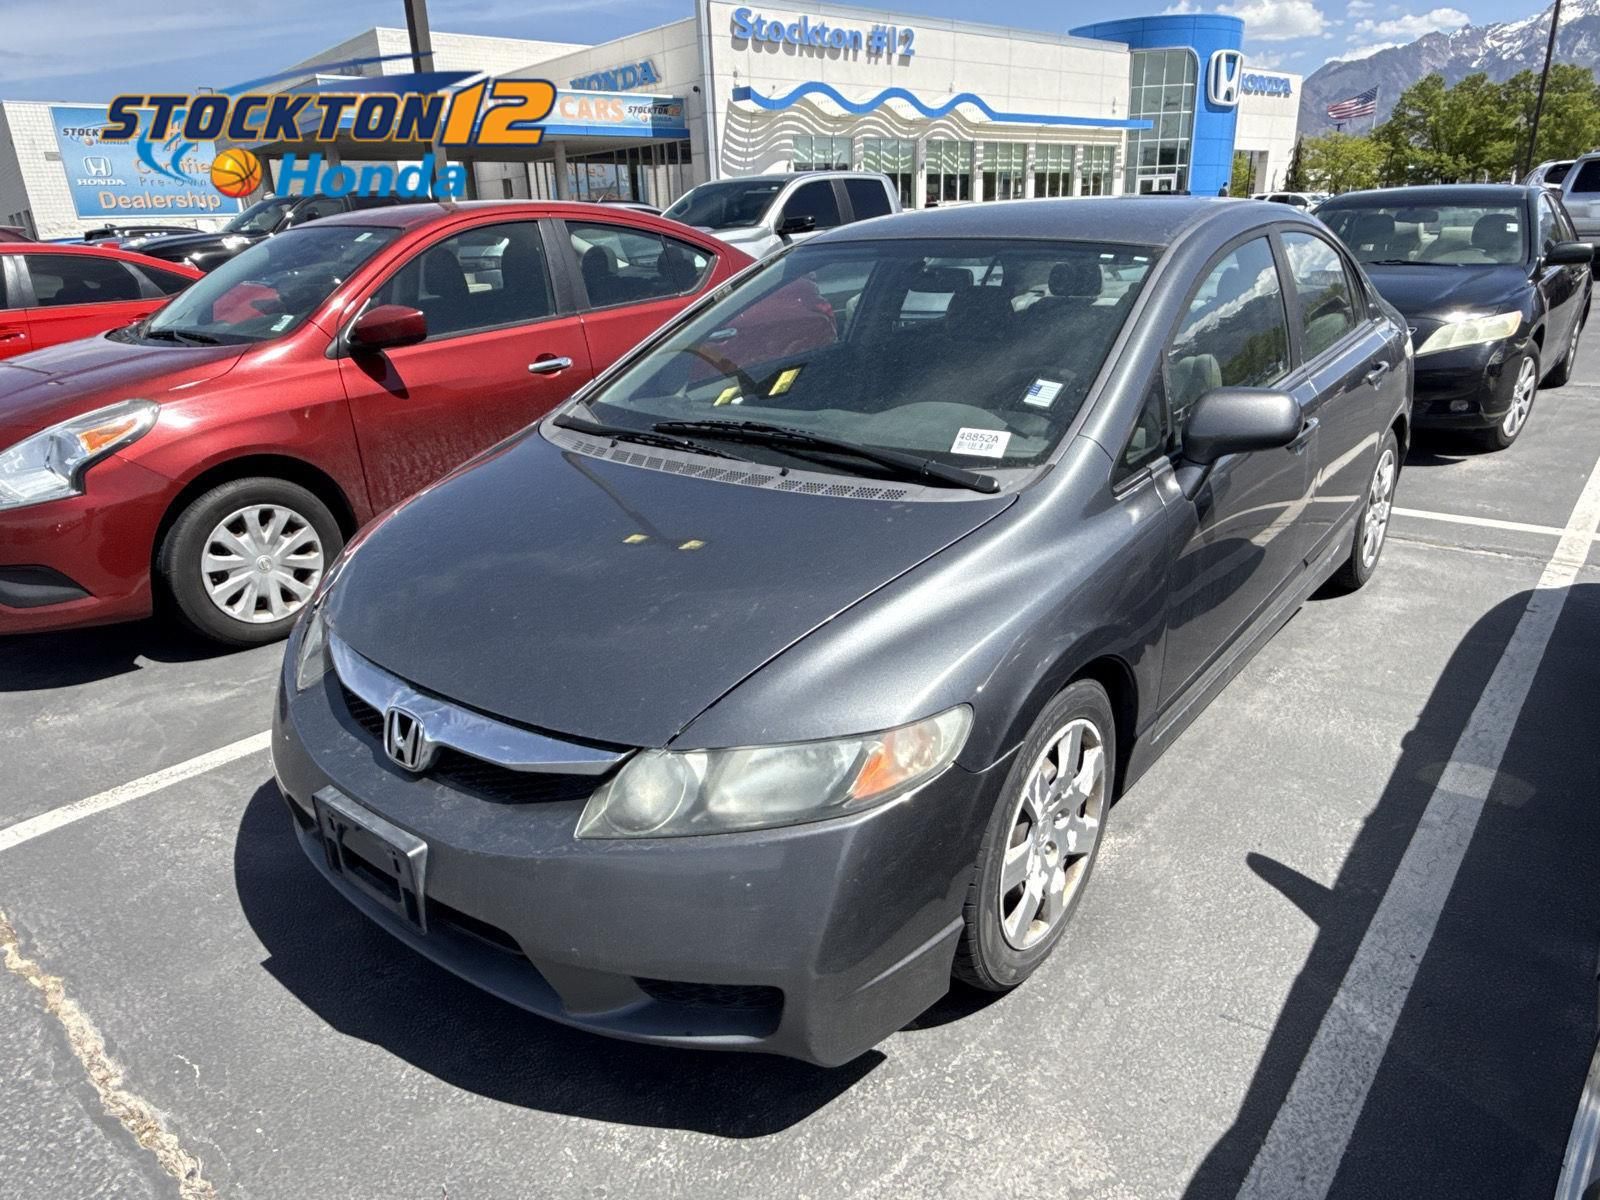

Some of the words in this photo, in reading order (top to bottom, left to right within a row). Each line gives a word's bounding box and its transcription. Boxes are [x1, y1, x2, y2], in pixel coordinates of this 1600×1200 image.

[733, 7, 862, 50] Stockton
[868, 24, 916, 57] #12
[569, 59, 661, 91] HONDA
[558, 95, 625, 123] CARS
[132, 157, 213, 174] Crifie
[76, 178, 126, 186] HONDA
[98, 190, 222, 211] Dealership
[959, 431, 999, 444] 48852A
